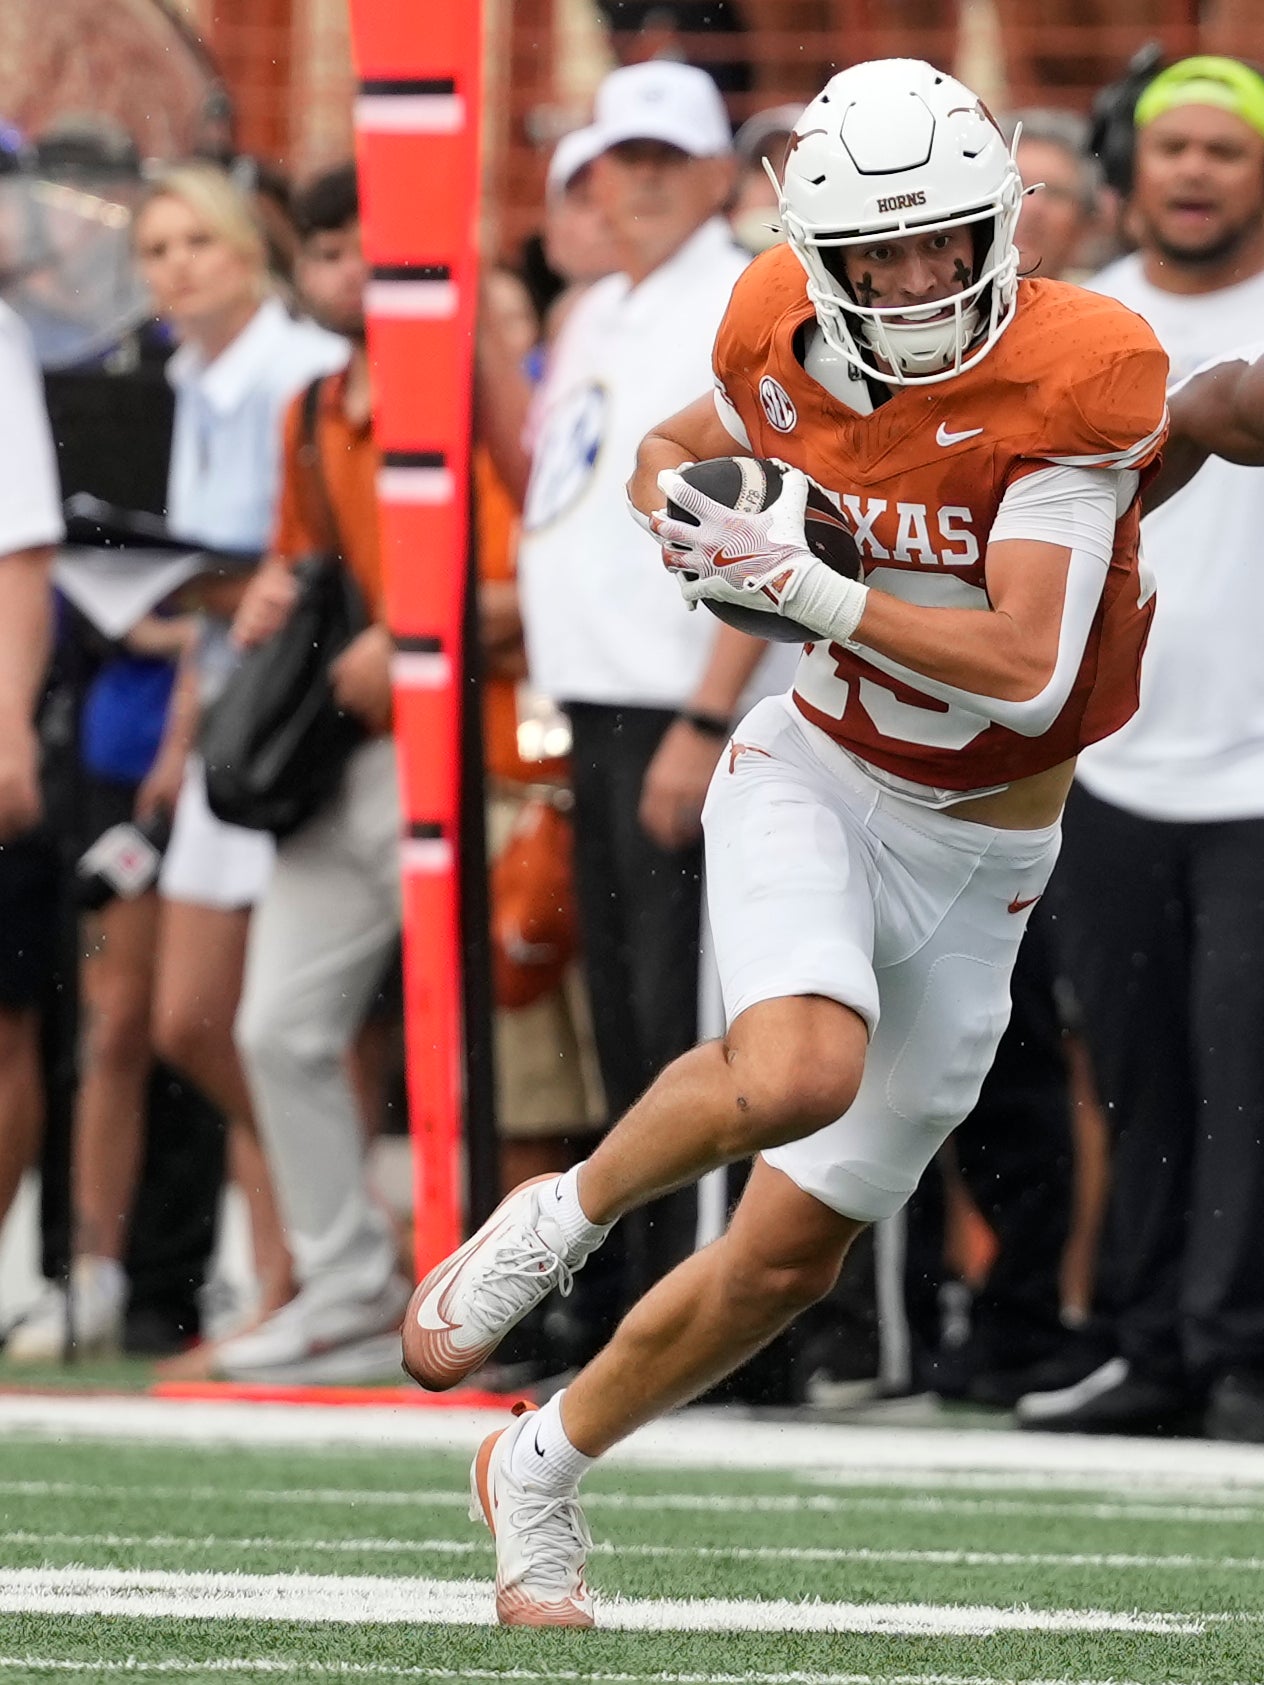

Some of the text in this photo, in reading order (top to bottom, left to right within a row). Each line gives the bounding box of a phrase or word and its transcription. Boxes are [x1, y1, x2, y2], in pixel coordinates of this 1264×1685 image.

[877, 191, 927, 213] HORNS
[761, 380, 795, 429] SEC
[821, 489, 980, 566] XAS
